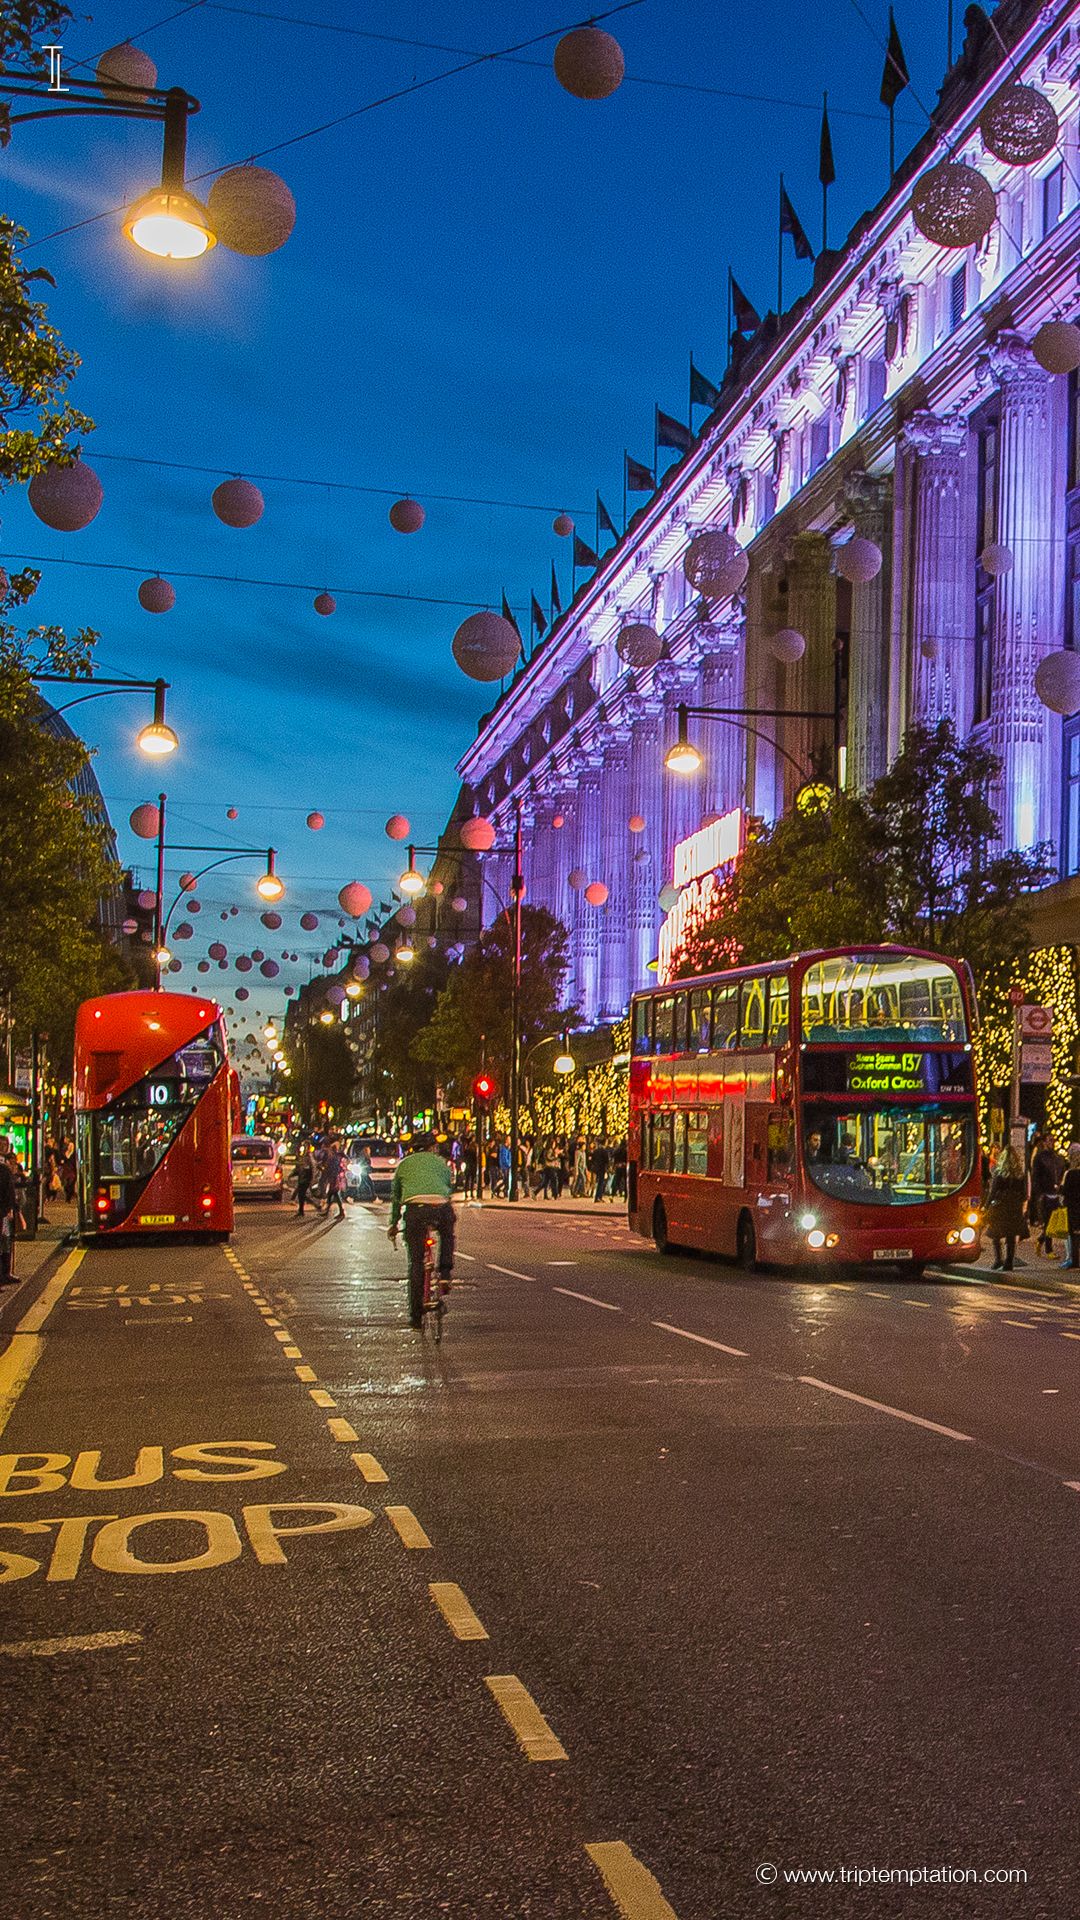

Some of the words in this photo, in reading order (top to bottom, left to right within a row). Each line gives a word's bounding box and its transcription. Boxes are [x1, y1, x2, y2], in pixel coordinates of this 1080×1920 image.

[851, 1076, 889, 1090] Oxford
[891, 1076, 925, 1090] Circus
[150, 1085, 168, 1105] 10
[70, 1282, 204, 1296] BUS
[66, 1293, 232, 1310] STOP
[0, 1440, 287, 1497] BUS
